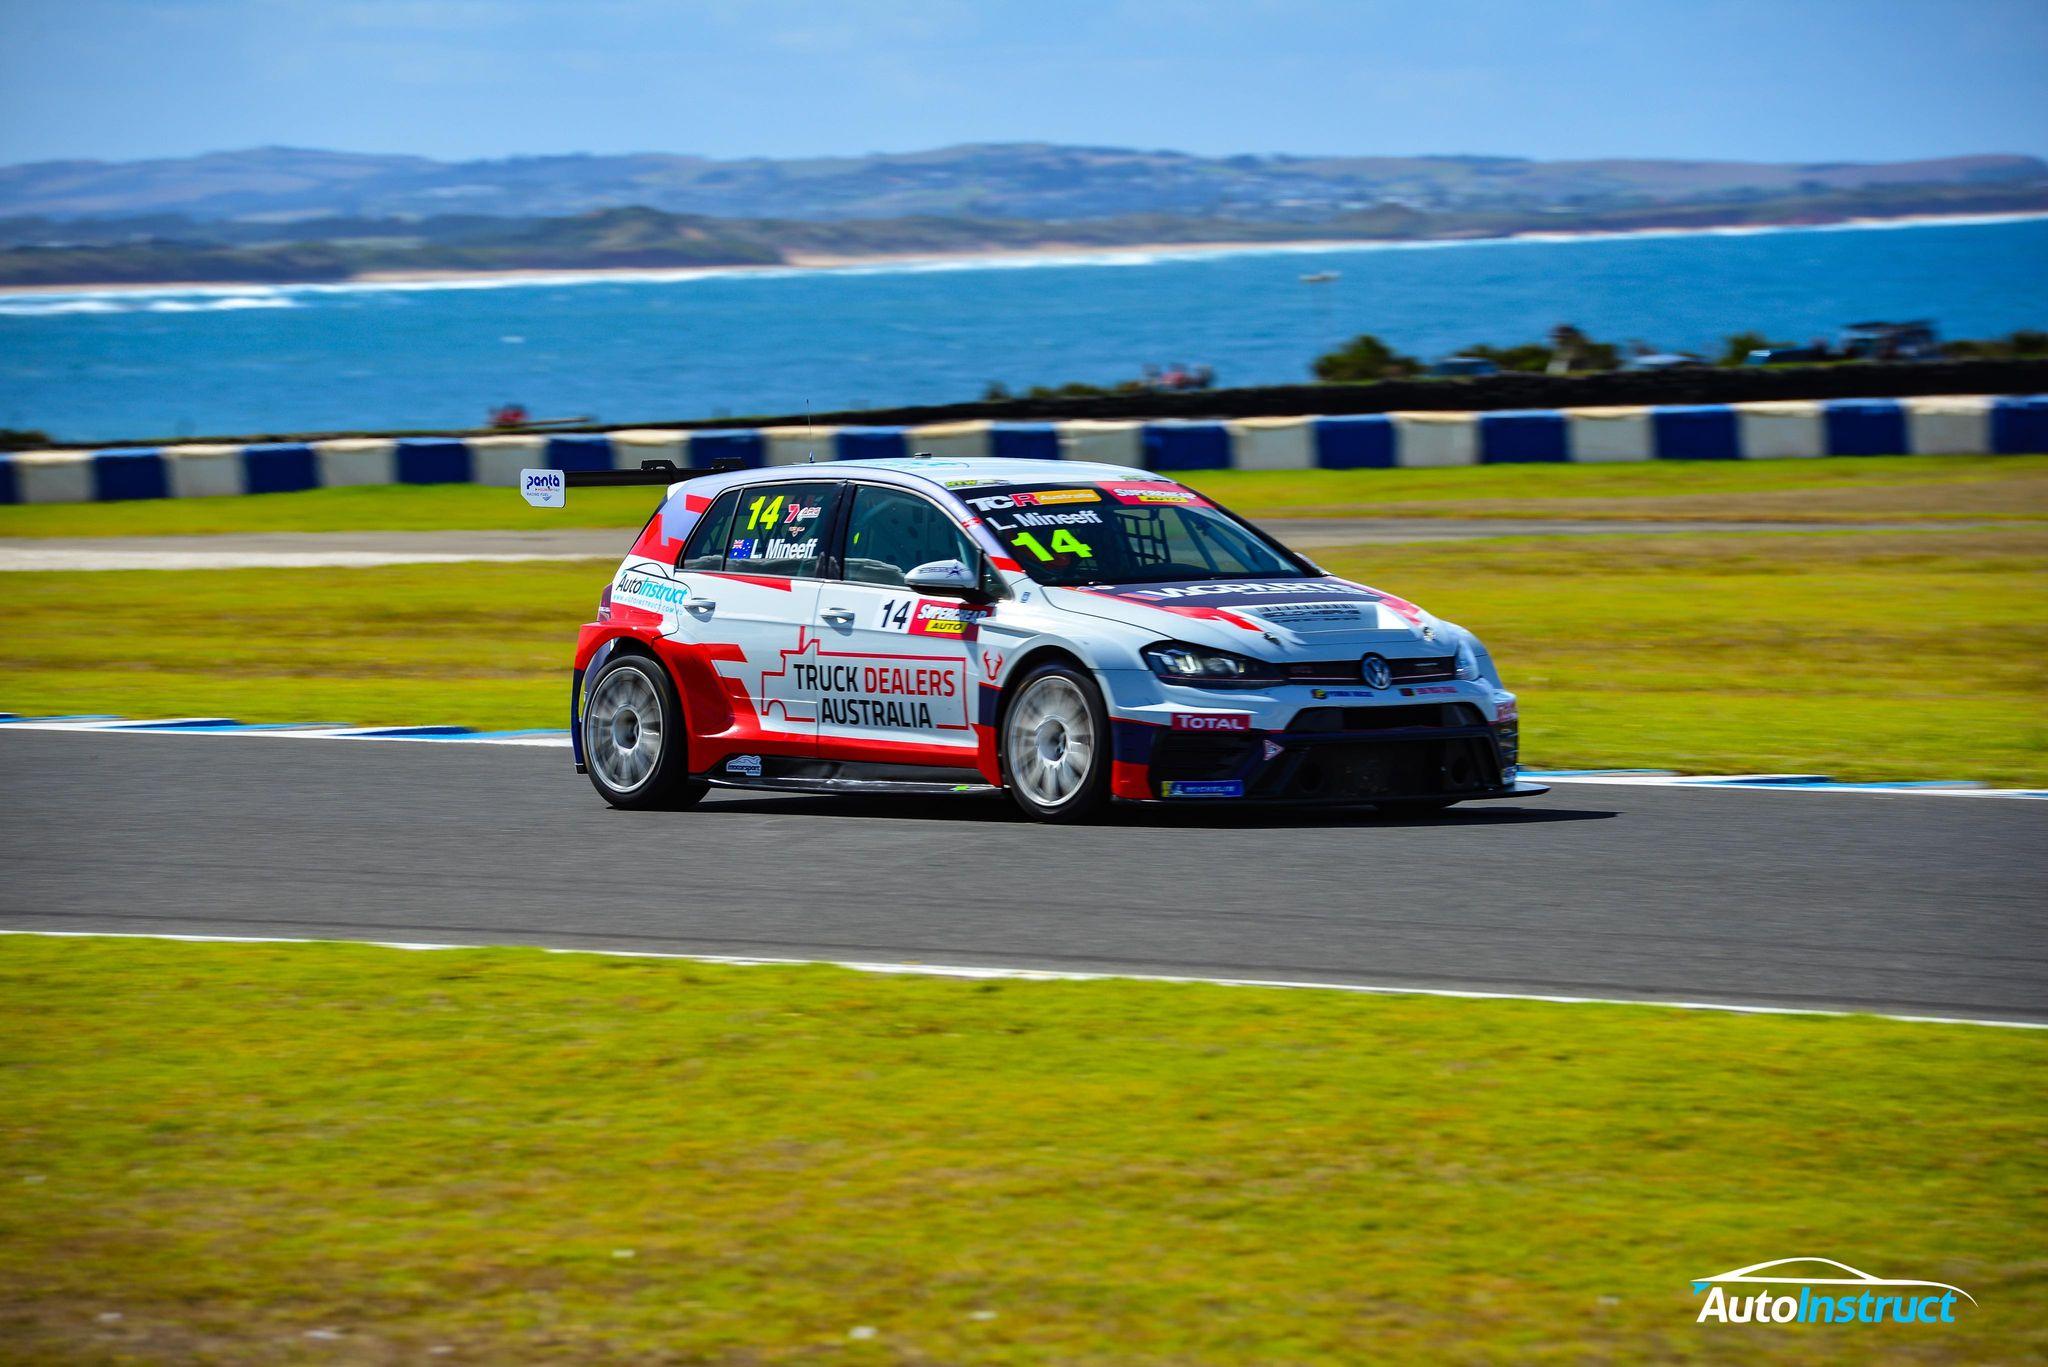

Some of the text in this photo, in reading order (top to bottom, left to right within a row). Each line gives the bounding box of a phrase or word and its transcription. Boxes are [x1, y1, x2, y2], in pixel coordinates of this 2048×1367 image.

[746, 495, 785, 530] 14
[966, 493, 1042, 512] TCR
[986, 510, 1103, 530] L. Mineeff
[750, 538, 819, 560] L. Mineeff
[1010, 528, 1093, 562] 14
[615, 574, 688, 610] AutoInstruct
[881, 599, 912, 629] 14
[931, 622, 962, 632] AUTO
[793, 663, 955, 697] TRUCK DEALERS
[821, 698, 933, 728] AUSTRALIA
[1177, 714, 1245, 730] TOTAL
